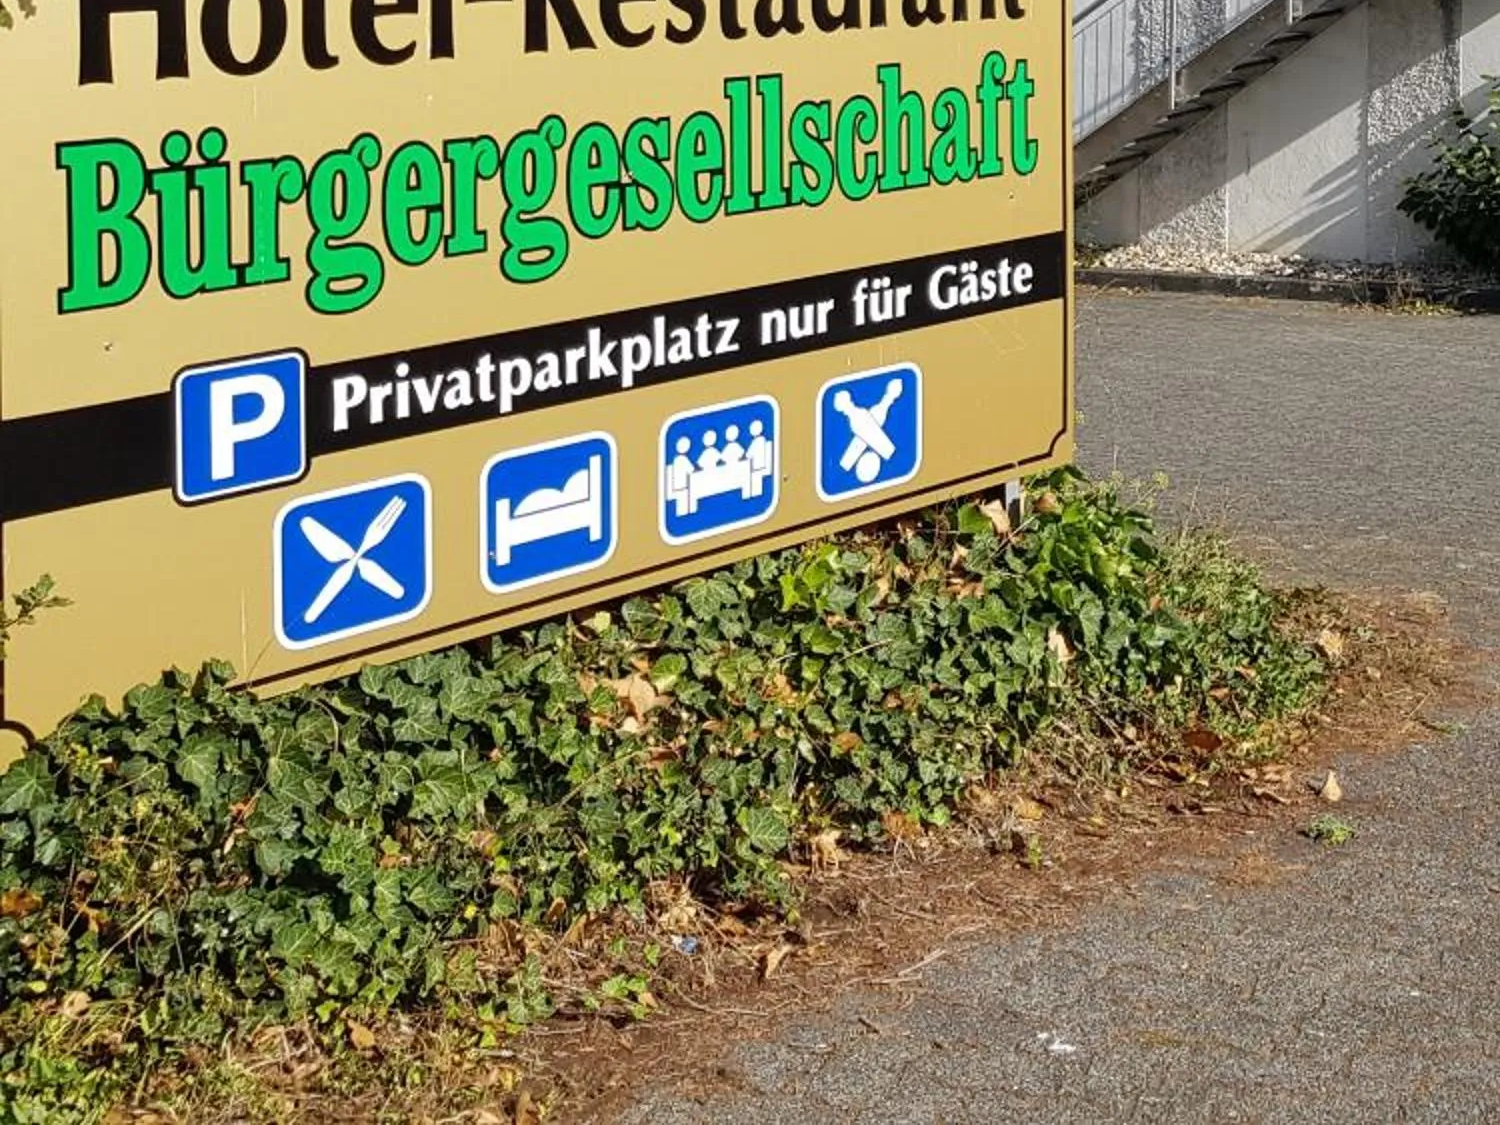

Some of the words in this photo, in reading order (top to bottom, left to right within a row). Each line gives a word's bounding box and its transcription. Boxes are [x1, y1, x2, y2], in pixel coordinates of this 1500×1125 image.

[56, 50, 1038, 315] Bürgergesellschaft
[210, 374, 285, 481] P
[332, 313, 740, 431] Privatparkplatz
[760, 298, 834, 345] nur
[852, 276, 912, 325] für
[928, 257, 1034, 310] Gäste
